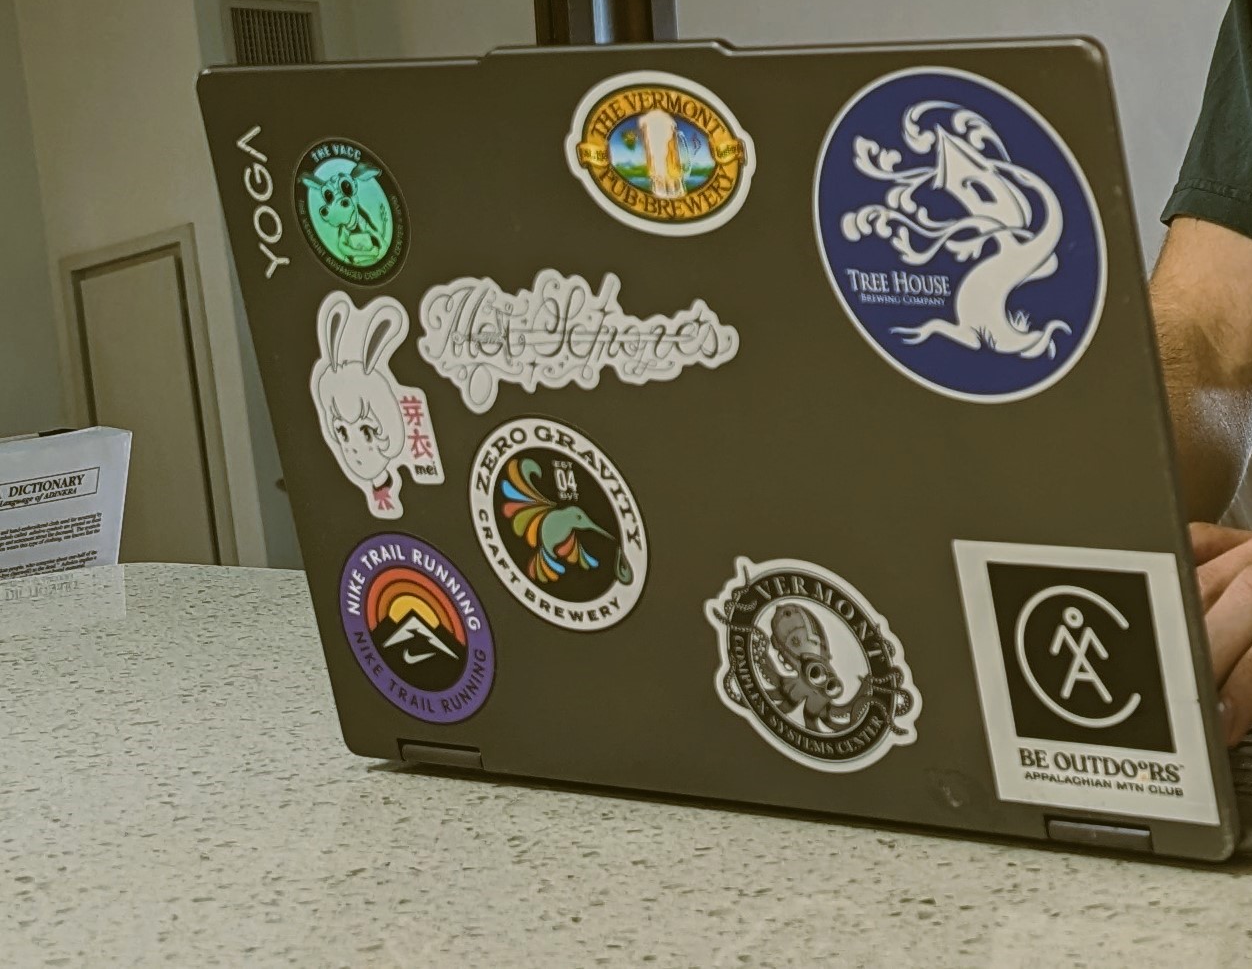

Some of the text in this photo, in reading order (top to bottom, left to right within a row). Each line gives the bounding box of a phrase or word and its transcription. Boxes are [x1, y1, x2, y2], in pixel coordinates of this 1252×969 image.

[591, 91, 727, 138] THE VERMONT
[310, 143, 361, 163] THE VACC
[236, 125, 290, 279] YOGA
[846, 268, 952, 297] TREE HOUSE
[860, 292, 945, 305] BREWING COMPANY
[400, 396, 433, 459] 芽衣
[414, 461, 438, 475] mei
[552, 460, 573, 469] EST
[554, 468, 578, 492] 04
[8, 474, 85, 497] DICTIONARY
[476, 425, 643, 551] ZERO GRAVITY
[479, 509, 622, 622] CRAFT BREWERY
[347, 544, 481, 631] NIKE TRAIL RUNNING
[755, 575, 882, 657] VERMONT
[354, 632, 487, 714] NIKE TRAIL RUNNING
[770, 715, 835, 754] SYSTEMS
[835, 716, 883, 754] CENTER
[1018, 747, 1049, 769] BE
[1024, 771, 1184, 797] APPALACHIAN MTN CLUB
